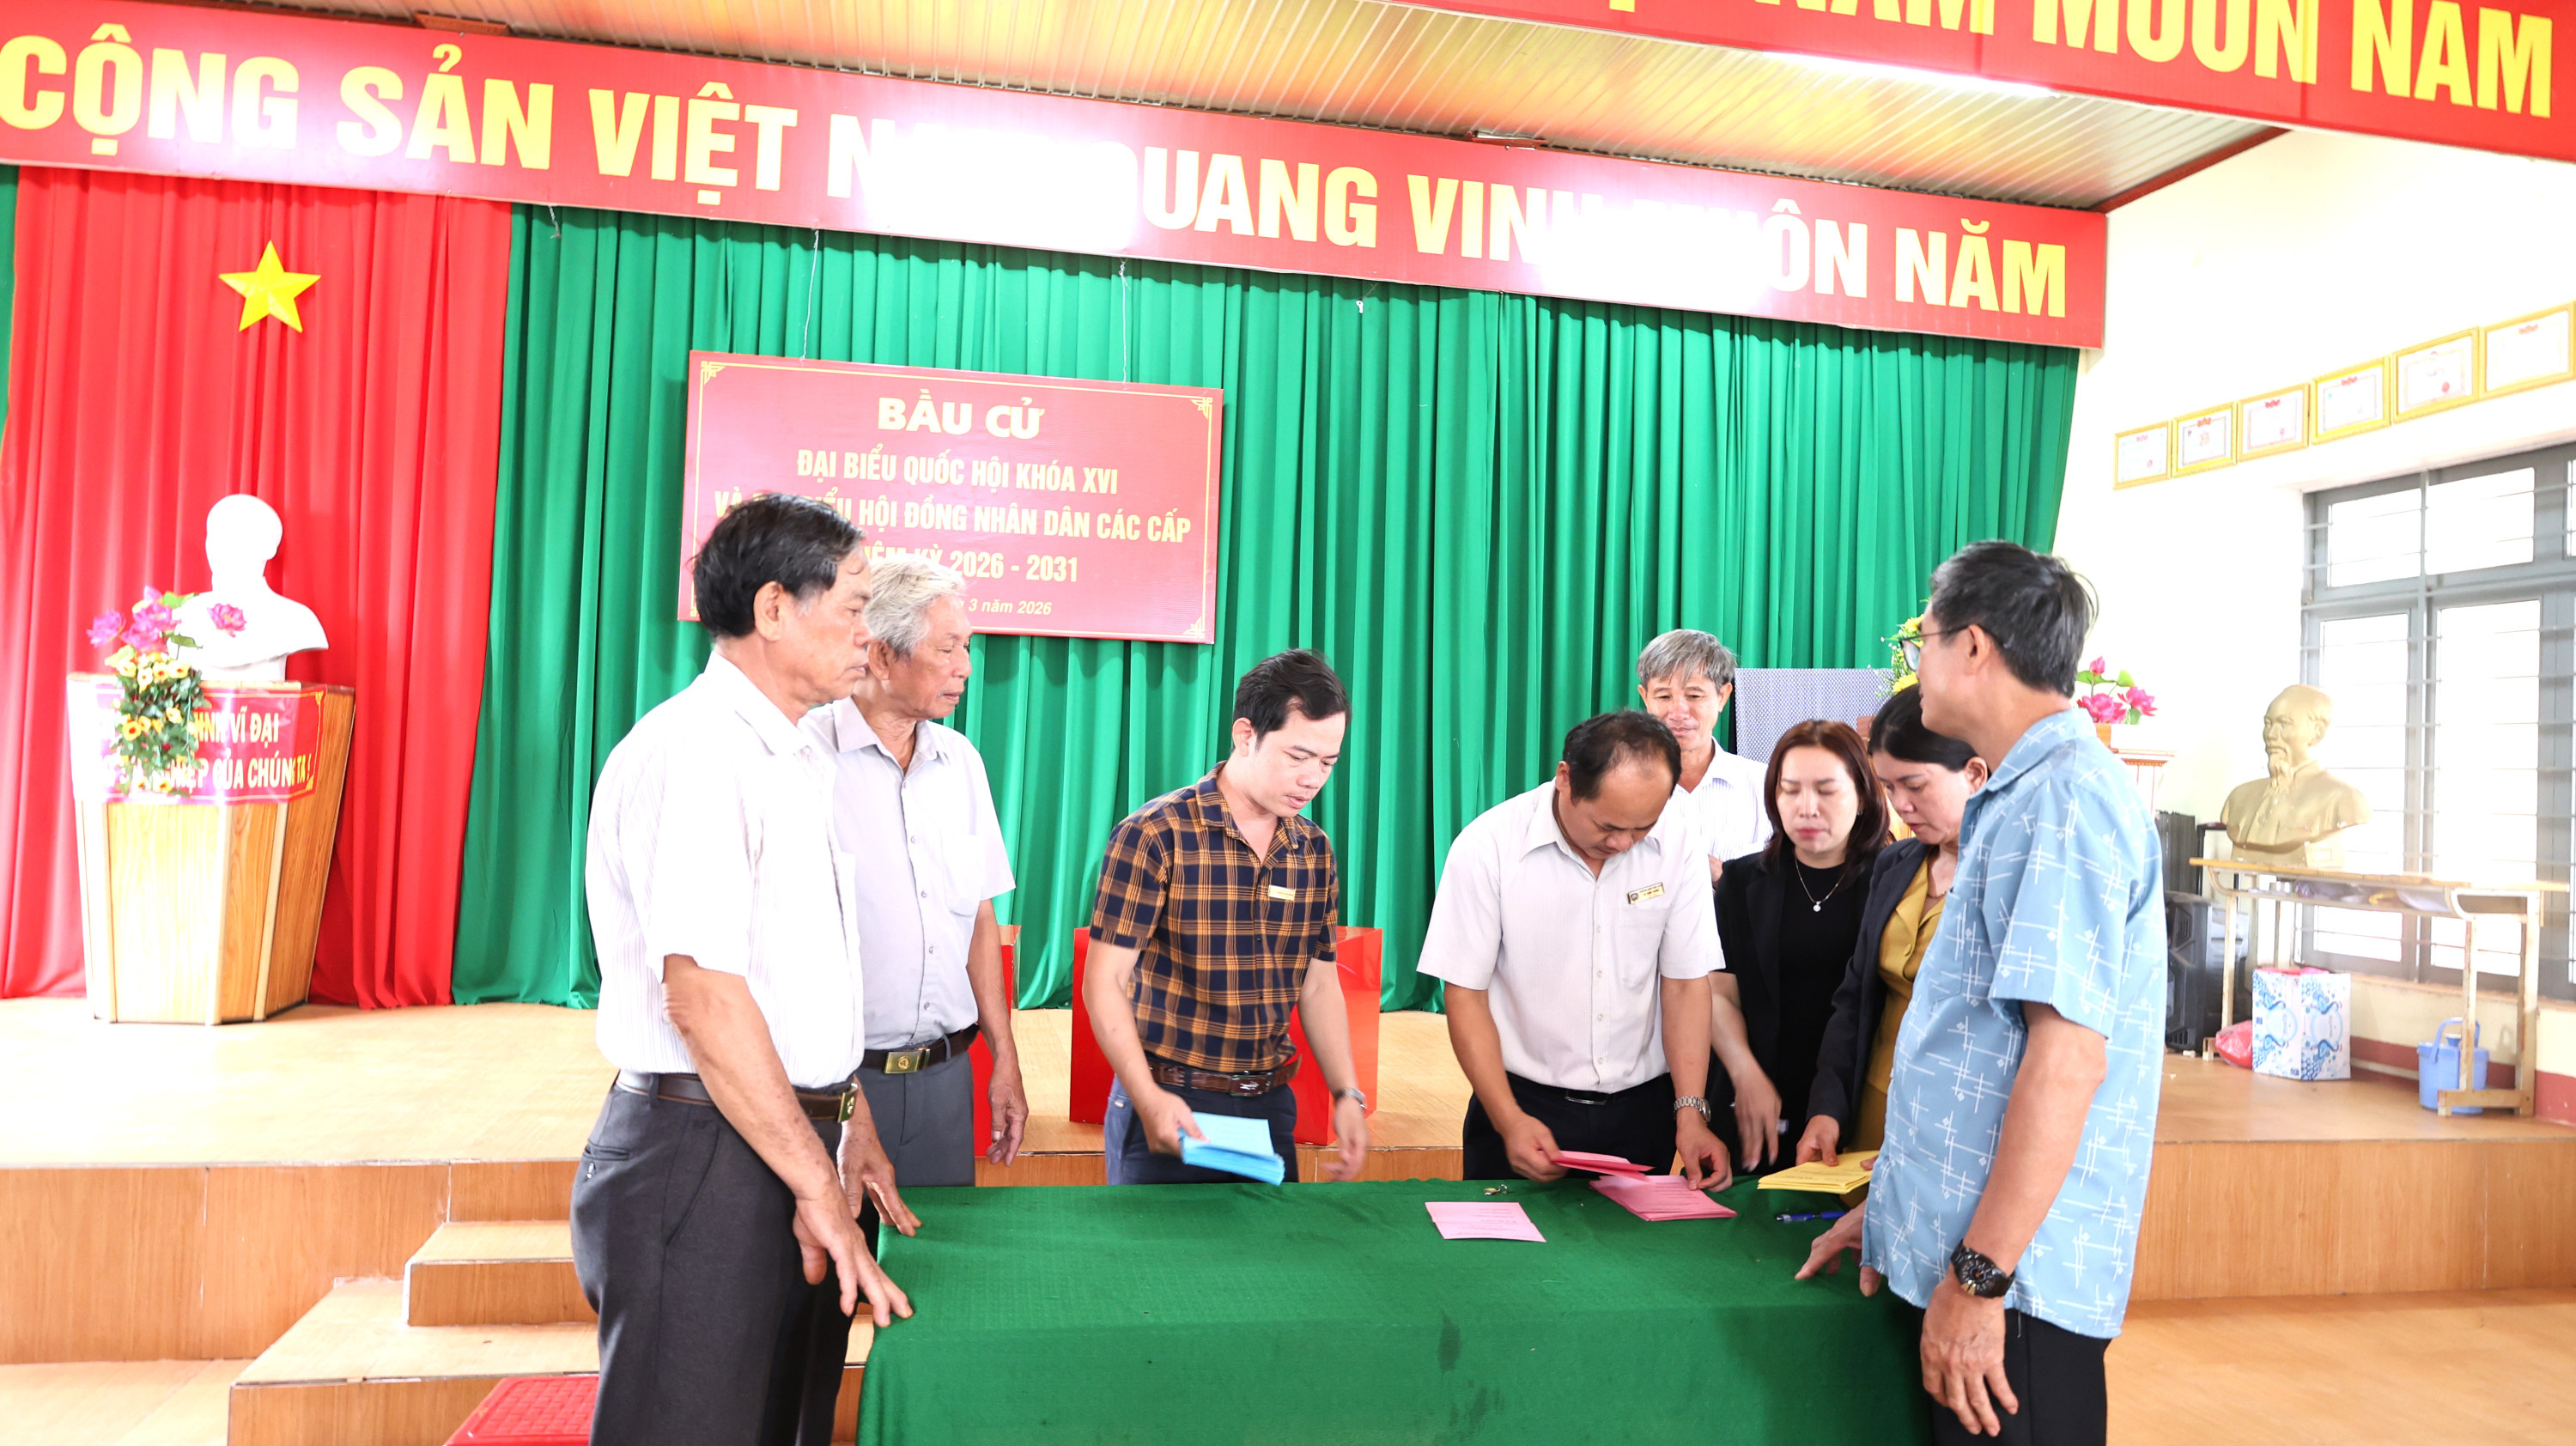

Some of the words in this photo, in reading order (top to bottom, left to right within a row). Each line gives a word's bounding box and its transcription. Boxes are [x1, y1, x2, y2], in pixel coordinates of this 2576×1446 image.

[0, 23, 299, 156] CỘNG
[337, 44, 554, 170] SẢN
[588, 82, 798, 206] VIỆT
[1895, 218, 2066, 318] NĂM
[878, 389, 973, 435] BẦU
[985, 397, 1045, 440] CỬ
[797, 449, 837, 483] ĐẠI
[844, 443, 897, 482] BIỂU
[903, 449, 965, 485] QUỐC
[971, 456, 1009, 493] HỘI
[1016, 459, 1076, 492] KHÓA
[1082, 467, 1118, 494] XVI
[859, 495, 897, 532] HỘI
[904, 494, 967, 532] ĐỒNG
[974, 502, 1037, 535] NHÂN
[1043, 506, 1091, 538] DÂN
[1097, 509, 1141, 541] CÁC
[1147, 508, 1192, 543] CẤP
[950, 550, 1005, 579] 2026
[1026, 555, 1078, 582] 2031
[968, 598, 978, 611] 3
[981, 599, 1012, 613] năm
[1017, 601, 1053, 616] 2026
[229, 705, 247, 744] VĨ
[250, 712, 279, 749] ĐẠI
[212, 747, 244, 790] CỦA
